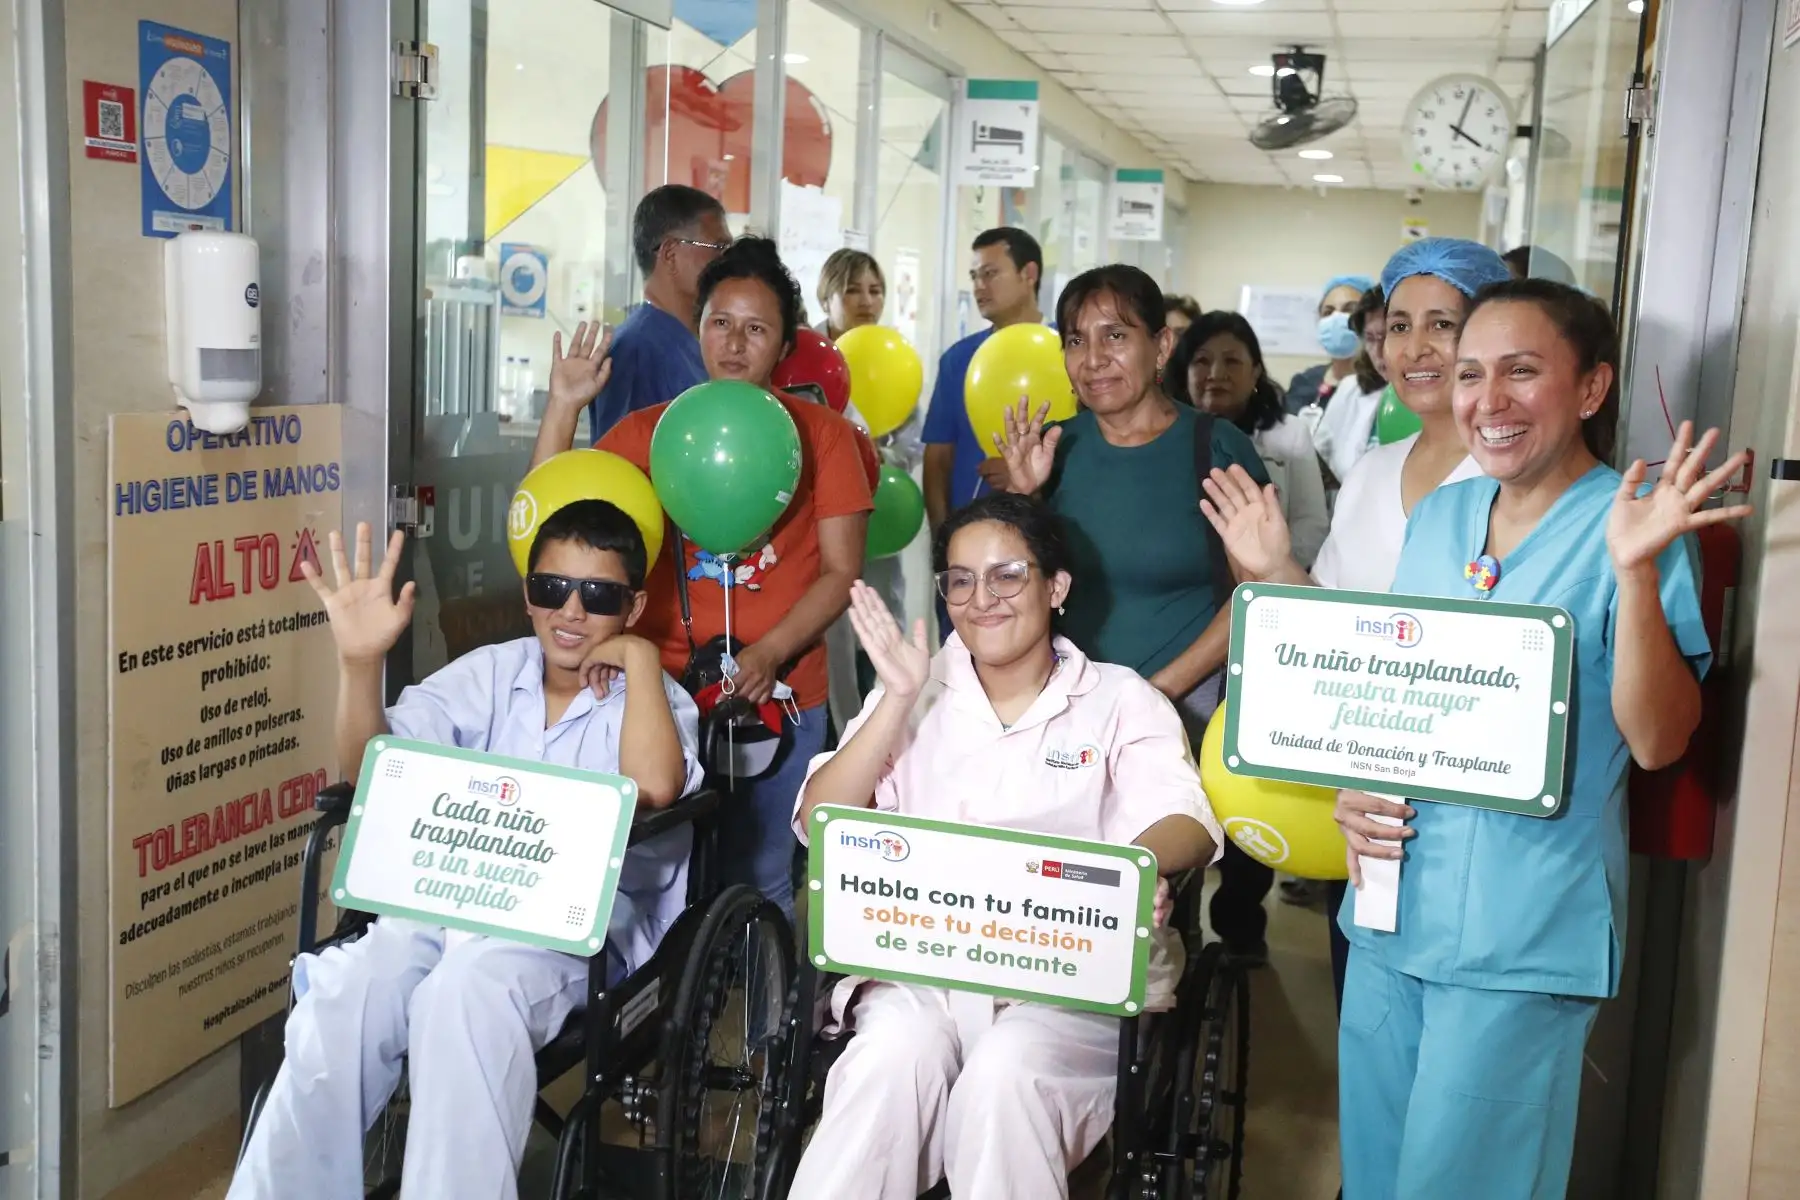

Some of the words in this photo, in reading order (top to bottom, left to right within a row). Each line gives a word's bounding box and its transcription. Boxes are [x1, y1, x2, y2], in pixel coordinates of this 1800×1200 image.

[115, 473, 219, 516] HIGIENE
[226, 470, 258, 503] DE
[263, 462, 340, 499] MANOS
[189, 532, 281, 605] ALTO
[118, 650, 138, 674] En
[141, 643, 175, 668] este
[177, 627, 234, 659] servicio
[236, 618, 266, 643] está
[1355, 616, 1395, 634] insn
[201, 653, 272, 692] prohibido:
[1274, 642, 1308, 668] Un
[1312, 648, 1366, 674] niño
[1367, 653, 1521, 693] trasplantado,
[200, 704, 222, 724] Uso
[224, 697, 239, 715] de
[240, 686, 272, 710] reloj.
[1313, 677, 1398, 704] nuestra
[1401, 689, 1481, 717] mayor
[1329, 701, 1435, 735] felicidad
[161, 746, 184, 766] Uso
[186, 738, 202, 757] de
[203, 725, 244, 750] anillos
[245, 723, 253, 737] o
[254, 706, 305, 737] pulseras.
[1269, 730, 1324, 752] Unidad
[1325, 739, 1343, 754] de
[1346, 740, 1415, 763] Donación
[1418, 752, 1429, 769] y
[1432, 750, 1512, 776] Trasplante
[166, 767, 197, 793] Uñas
[198, 756, 237, 780] largas
[239, 753, 247, 767] o
[248, 736, 301, 768] pintadas.
[468, 776, 499, 793] insn
[1349, 760, 1372, 771] INSN
[1373, 763, 1391, 774] San
[1392, 766, 1417, 778] Borja
[132, 788, 274, 878] TOLERANCIA
[432, 792, 491, 826] Cada
[494, 807, 550, 835] niño
[410, 817, 559, 864] trasplantado
[840, 831, 881, 850] insn
[140, 879, 171, 910] para
[173, 873, 186, 891] el
[187, 864, 210, 889] que
[211, 856, 227, 875] no
[228, 850, 242, 867] se
[243, 839, 268, 863] lave
[269, 832, 286, 850] las
[412, 849, 435, 868] es
[438, 856, 470, 876] un
[473, 863, 543, 888] sueño
[119, 883, 220, 945] adecuadamente
[222, 885, 230, 900] o
[231, 858, 282, 894] incumpla
[283, 852, 299, 871] las
[414, 876, 521, 912] cumplido
[840, 873, 919, 901] Habla
[928, 888, 975, 910] con
[984, 894, 1013, 915] tu
[1022, 898, 1119, 932] familia
[125, 965, 168, 1000] Disculpen
[168, 956, 181, 976] las
[223, 921, 257, 950] estamos
[256, 901, 298, 935] trabajando
[863, 904, 936, 930] sobre
[944, 914, 972, 935] tu
[981, 919, 1093, 954] decisión
[875, 931, 908, 951] de
[916, 939, 958, 959] ser
[966, 944, 1078, 977] donante
[178, 965, 214, 998] nuestros
[203, 984, 268, 1031] Hospitalización
